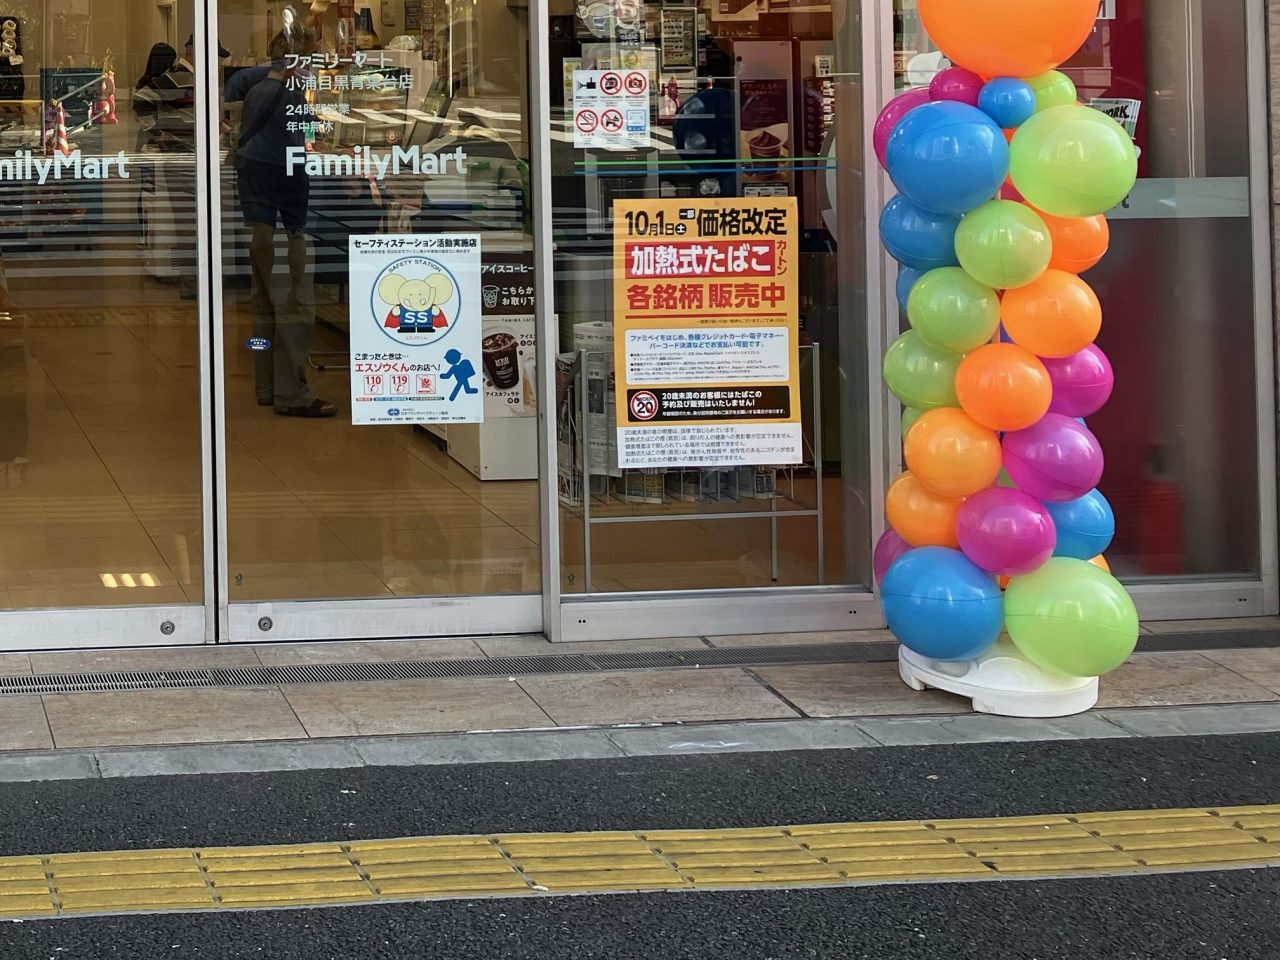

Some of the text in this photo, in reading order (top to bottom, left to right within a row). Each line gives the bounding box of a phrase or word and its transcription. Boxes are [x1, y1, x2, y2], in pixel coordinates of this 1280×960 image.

[284, 52, 393, 69] ファミリーマート
[285, 74, 414, 90] 小浦目黒青葉台店
[285, 104, 350, 117] 24時間営業
[285, 120, 334, 133] 年中無休
[285, 144, 467, 180] FamilyMart
[697, 208, 787, 236] 価格改定
[354, 239, 477, 248] セーフティステーション活動実施店
[631, 240, 787, 275] 加熱式たばこ カートン
[389, 259, 442, 273] SAFETY STATION
[627, 282, 785, 310] 各銘柄 販売中
[404, 311, 428, 324] SS
[365, 376, 407, 385] 110 119
